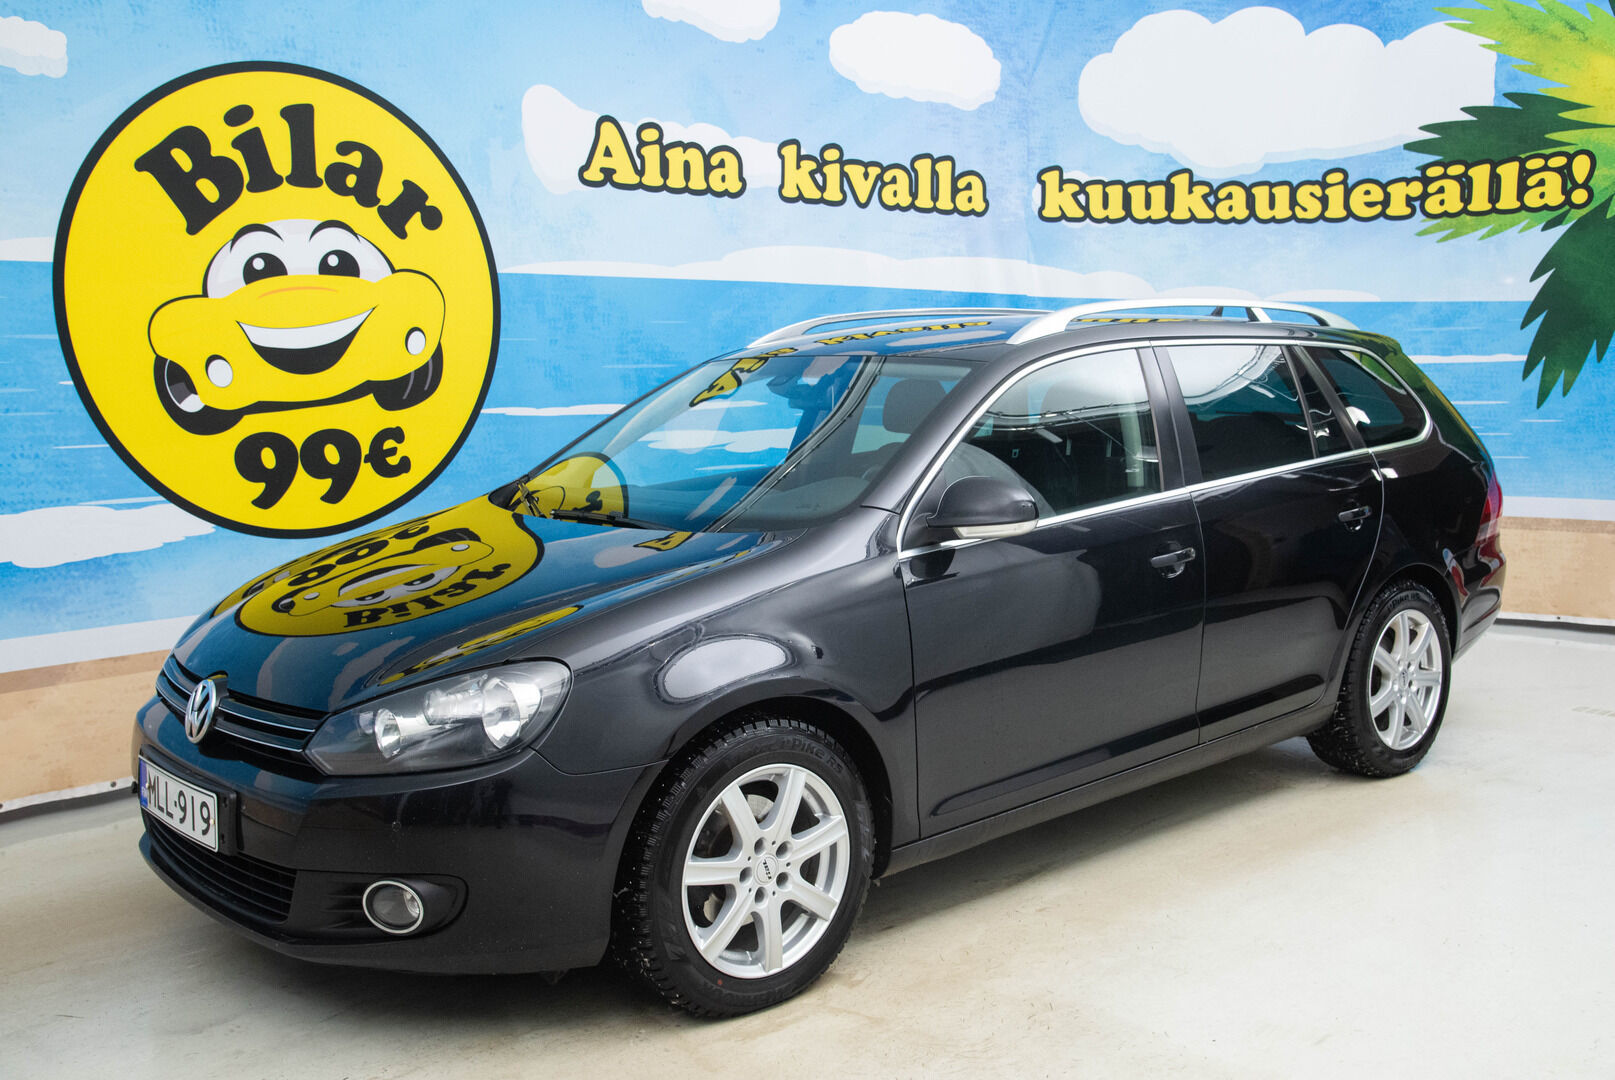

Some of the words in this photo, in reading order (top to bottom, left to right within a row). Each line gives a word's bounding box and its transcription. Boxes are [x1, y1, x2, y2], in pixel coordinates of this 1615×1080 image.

[134, 103, 443, 240] Bilar
[578, 114, 747, 199] Aina
[777, 138, 989, 217] kivalla
[1036, 149, 1597, 223] kuukausierällä!
[234, 425, 411, 510] 99€
